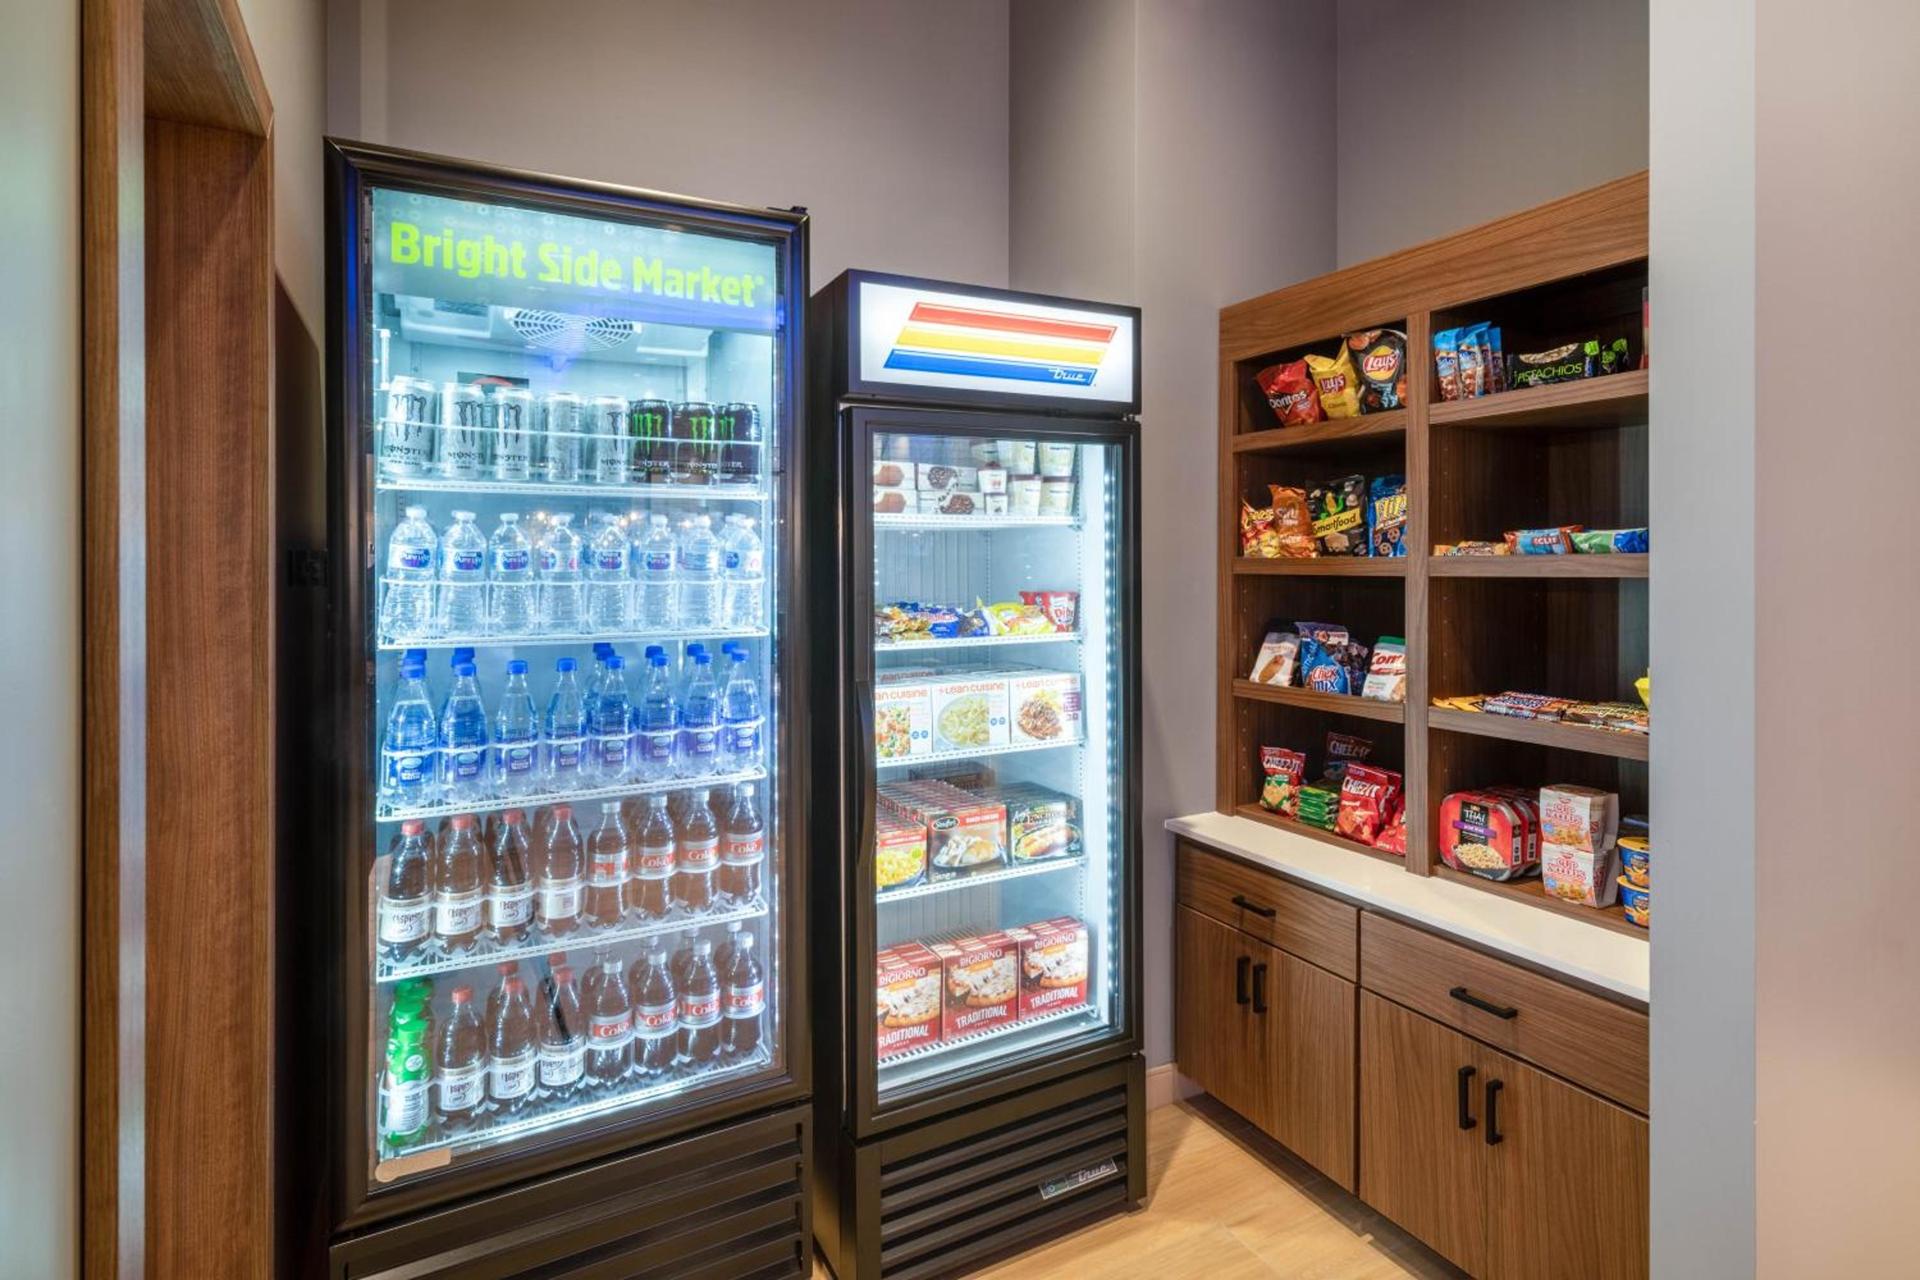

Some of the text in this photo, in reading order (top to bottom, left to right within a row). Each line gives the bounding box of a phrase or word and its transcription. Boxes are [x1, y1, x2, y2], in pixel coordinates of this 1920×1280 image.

[390, 222, 755, 308] Bright Side Market
[1269, 390, 1307, 409] Doritos
[1030, 986, 1079, 1009] TRADITIONAL
[956, 1004, 1007, 1030] TRADITIONAL
[600, 1021, 630, 1038] Coke
[877, 1024, 929, 1049] RADITIONAL
